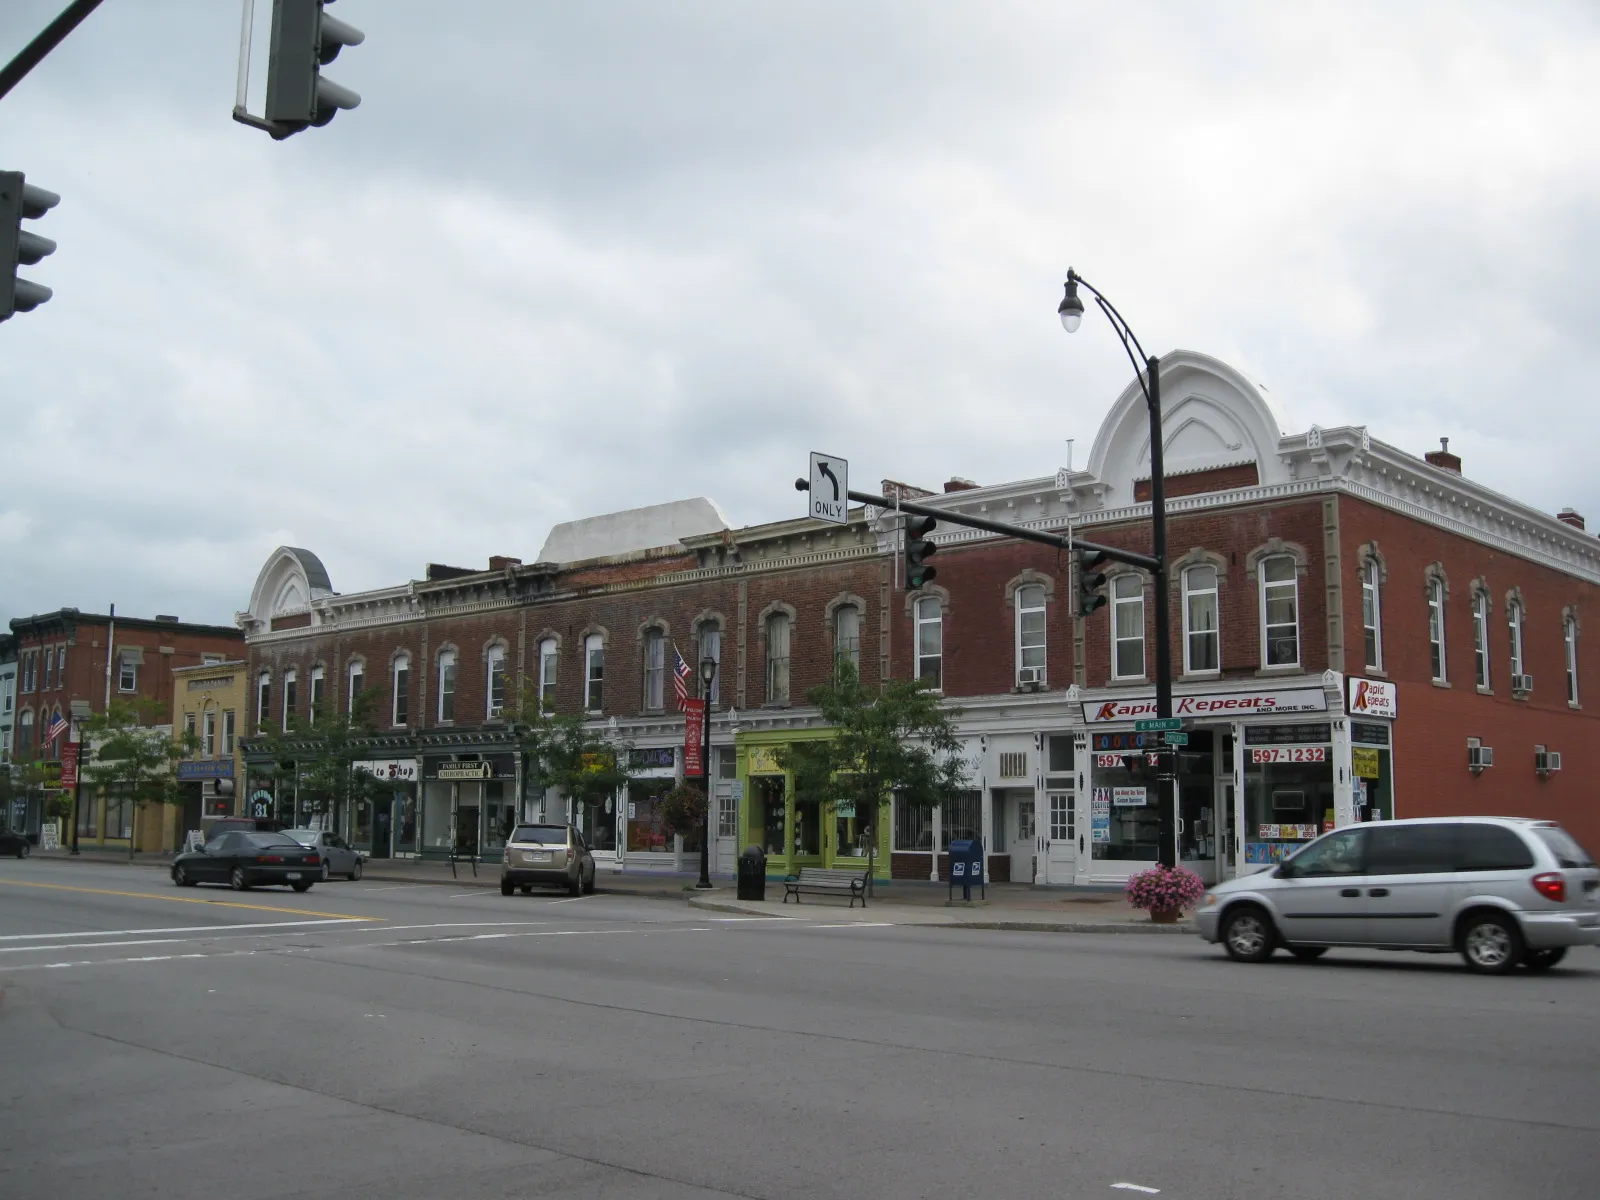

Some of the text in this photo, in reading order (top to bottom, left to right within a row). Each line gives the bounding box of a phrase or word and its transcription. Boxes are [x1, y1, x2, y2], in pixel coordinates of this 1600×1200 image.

[815, 501, 842, 518] ONLY
[1176, 696, 1276, 714] Repeats
[1141, 722, 1146, 730] E
[1149, 721, 1167, 729] MAIN
[1253, 748, 1324, 764] 597-1232
[388, 764, 414, 778] Shop
[440, 769, 481, 778] CHIROPRACTIC
[1092, 787, 1109, 801] FAX
[255, 803, 269, 818] 31
